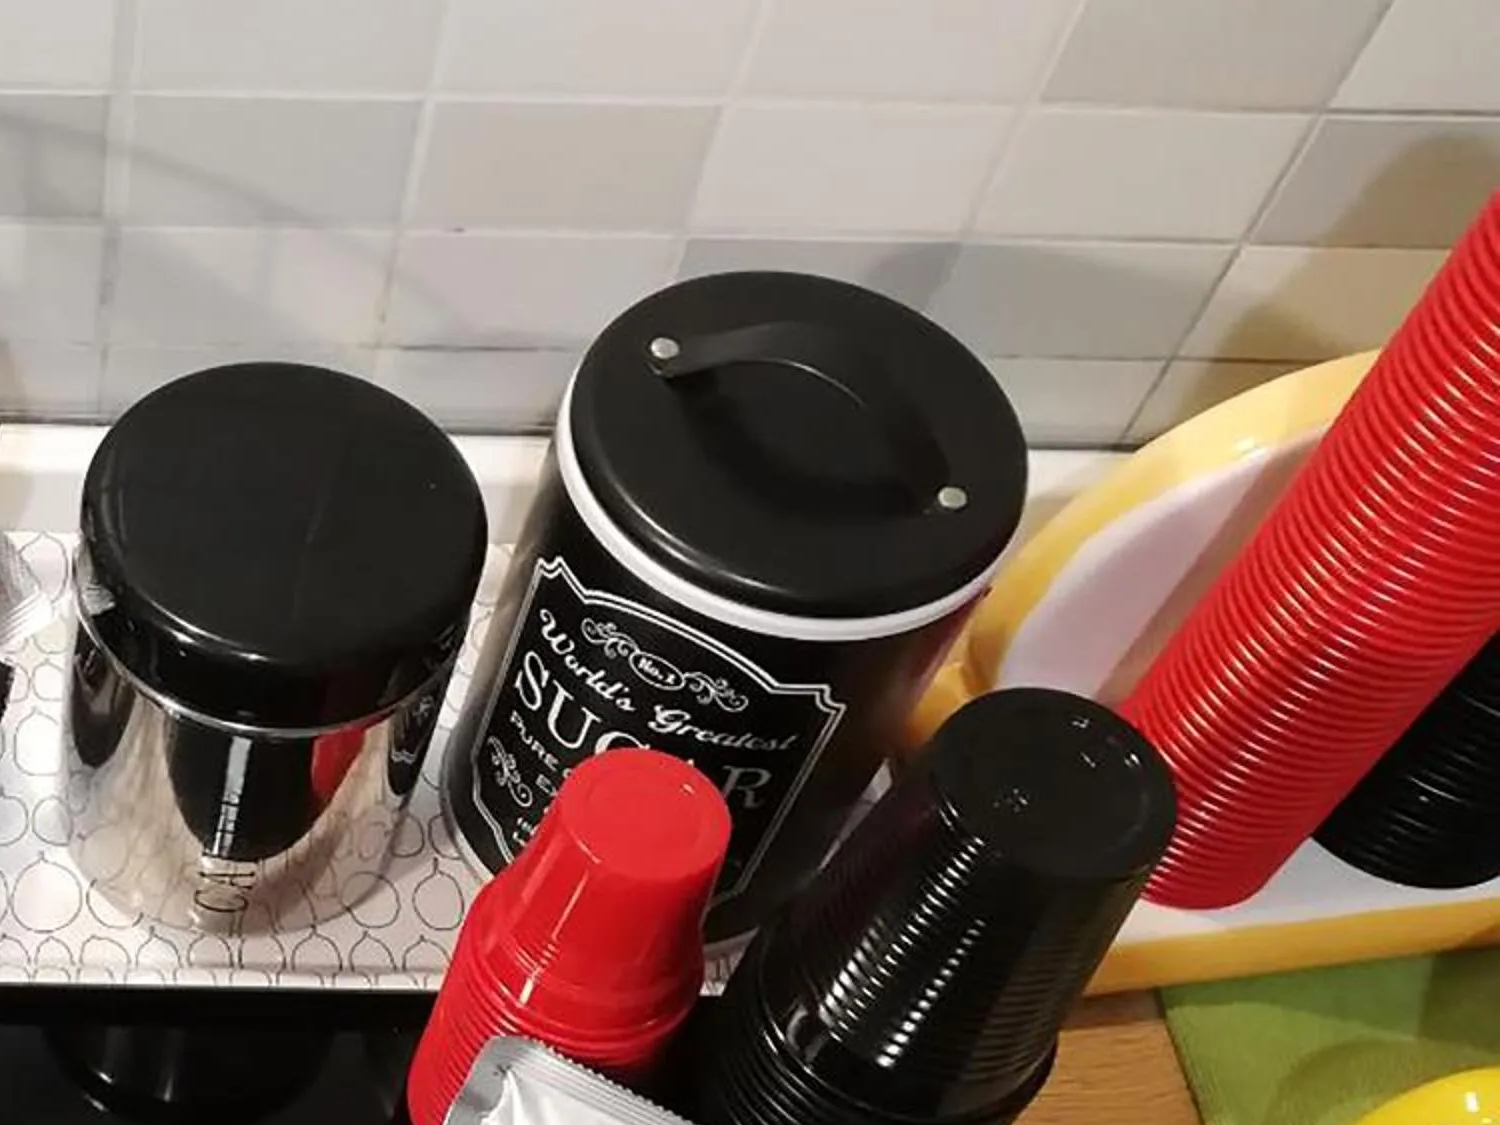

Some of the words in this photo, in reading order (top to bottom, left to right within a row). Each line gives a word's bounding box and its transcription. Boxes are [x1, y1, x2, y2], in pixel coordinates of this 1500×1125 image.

[509, 710, 559, 768] PURE
[514, 651, 772, 808] SUR
[539, 608, 635, 712] World's
[647, 704, 799, 751] Greatest
